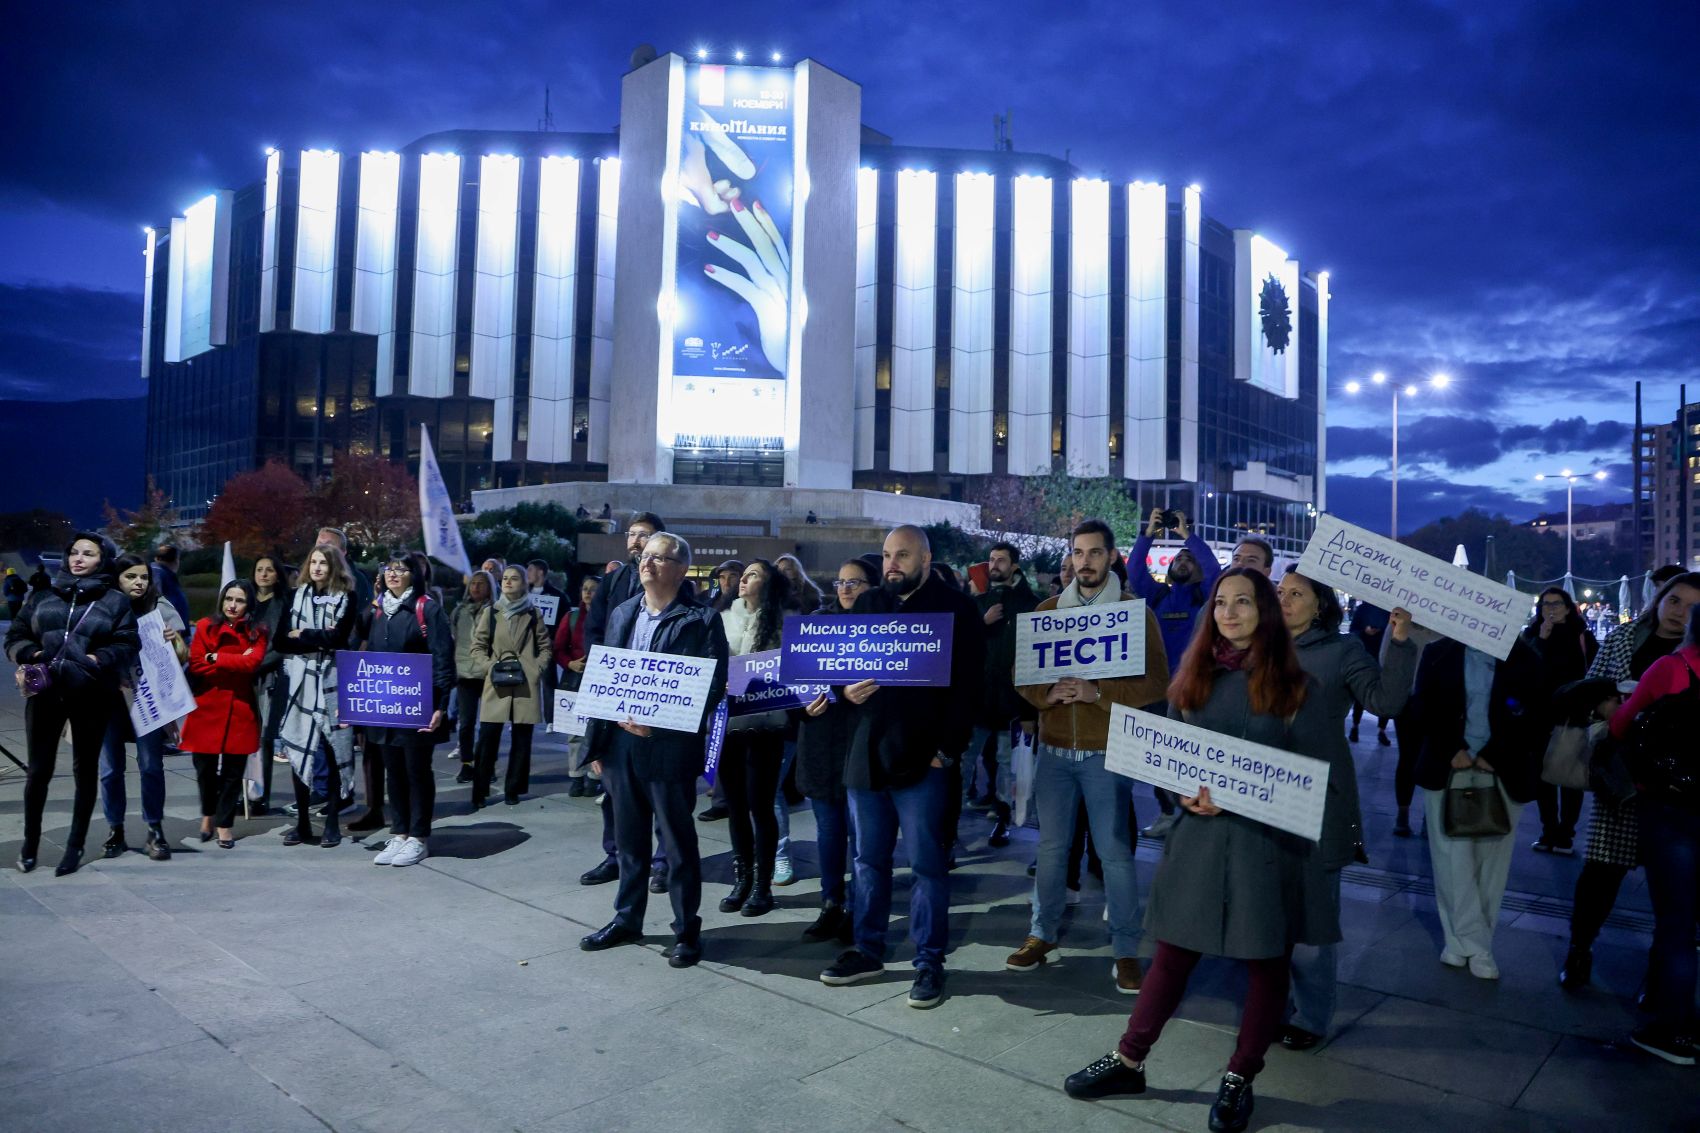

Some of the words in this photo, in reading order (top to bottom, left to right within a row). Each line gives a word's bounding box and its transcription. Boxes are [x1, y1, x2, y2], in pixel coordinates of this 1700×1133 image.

[1327, 529, 1402, 575] Докажи,
[1410, 564, 1429, 582] че
[1434, 575, 1454, 592] си
[1459, 583, 1512, 615] мъж!
[1318, 548, 1394, 593] ТЕСТвай
[1396, 587, 1507, 641] простатата!
[800, 622, 847, 635] Мисли
[850, 624, 867, 638] за
[870, 620, 907, 634] себе
[911, 624, 934, 636] си,
[1030, 614, 1101, 633] Твърдо
[1106, 610, 1128, 628] за
[790, 642, 835, 654] мисли
[838, 642, 855, 656] за
[860, 638, 941, 656] близките!
[1032, 632, 1128, 668] ТЕСТ!
[356, 658, 394, 678] Дръж
[397, 665, 411, 676] се
[600, 653, 616, 670] Аз
[620, 658, 636, 669] се
[640, 658, 702, 677] ТЕСТвах
[817, 658, 883, 671] ТЕСТвай
[886, 658, 909, 670] се!
[347, 678, 422, 696] есТЕСТвено!
[611, 672, 630, 685] за
[632, 674, 659, 688] рак
[661, 678, 679, 690] на
[589, 683, 694, 707] простатата.
[348, 698, 402, 714] ТЕСТвай
[405, 702, 422, 716] се!
[616, 700, 626, 712] А
[628, 704, 660, 717] ти?
[1123, 714, 1200, 757] Погрижи
[1206, 746, 1225, 764] се
[1232, 754, 1313, 790] навреме
[1145, 752, 1162, 768] за
[1168, 758, 1275, 804] простатата!
